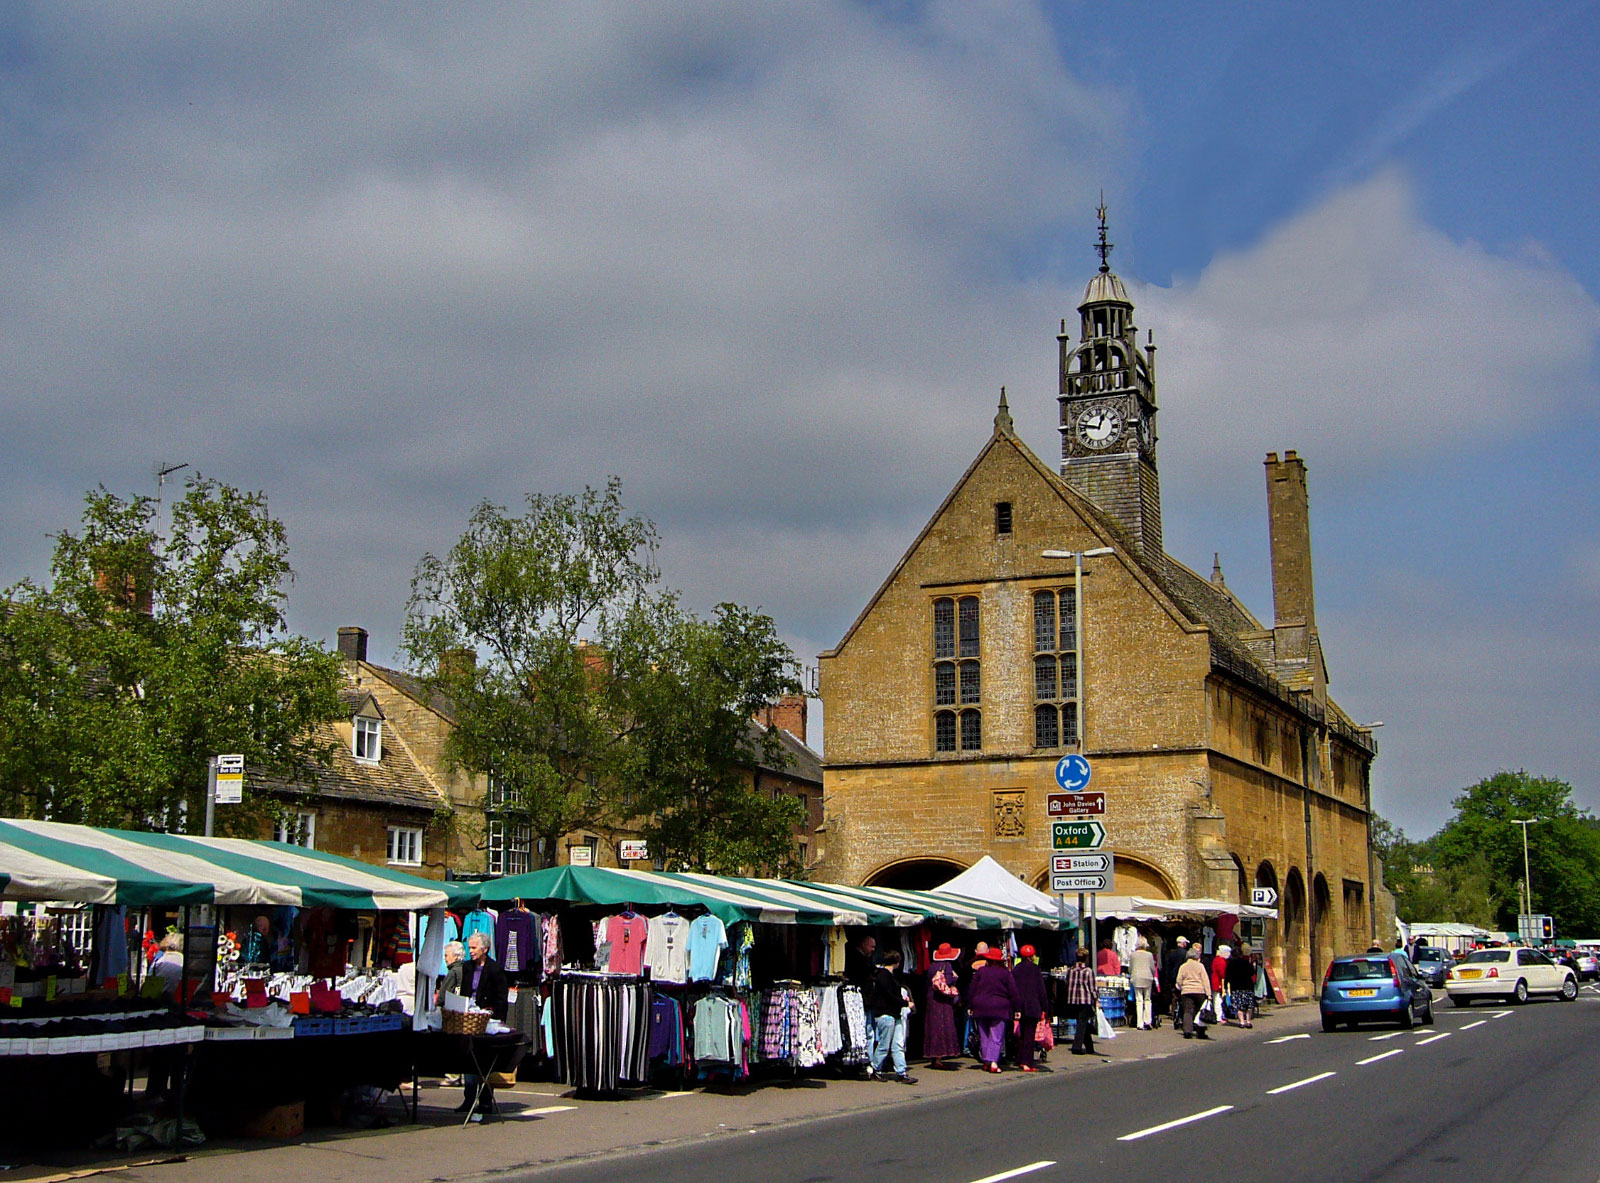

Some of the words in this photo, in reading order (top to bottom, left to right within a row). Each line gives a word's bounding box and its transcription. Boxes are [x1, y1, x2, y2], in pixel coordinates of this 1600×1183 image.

[1055, 825, 1088, 836] Oxford
[1056, 836, 1063, 846] A
[1064, 836, 1079, 845] 44
[1073, 860, 1099, 868] Station
[1074, 878, 1096, 886] Office
[1255, 891, 1263, 901] P
